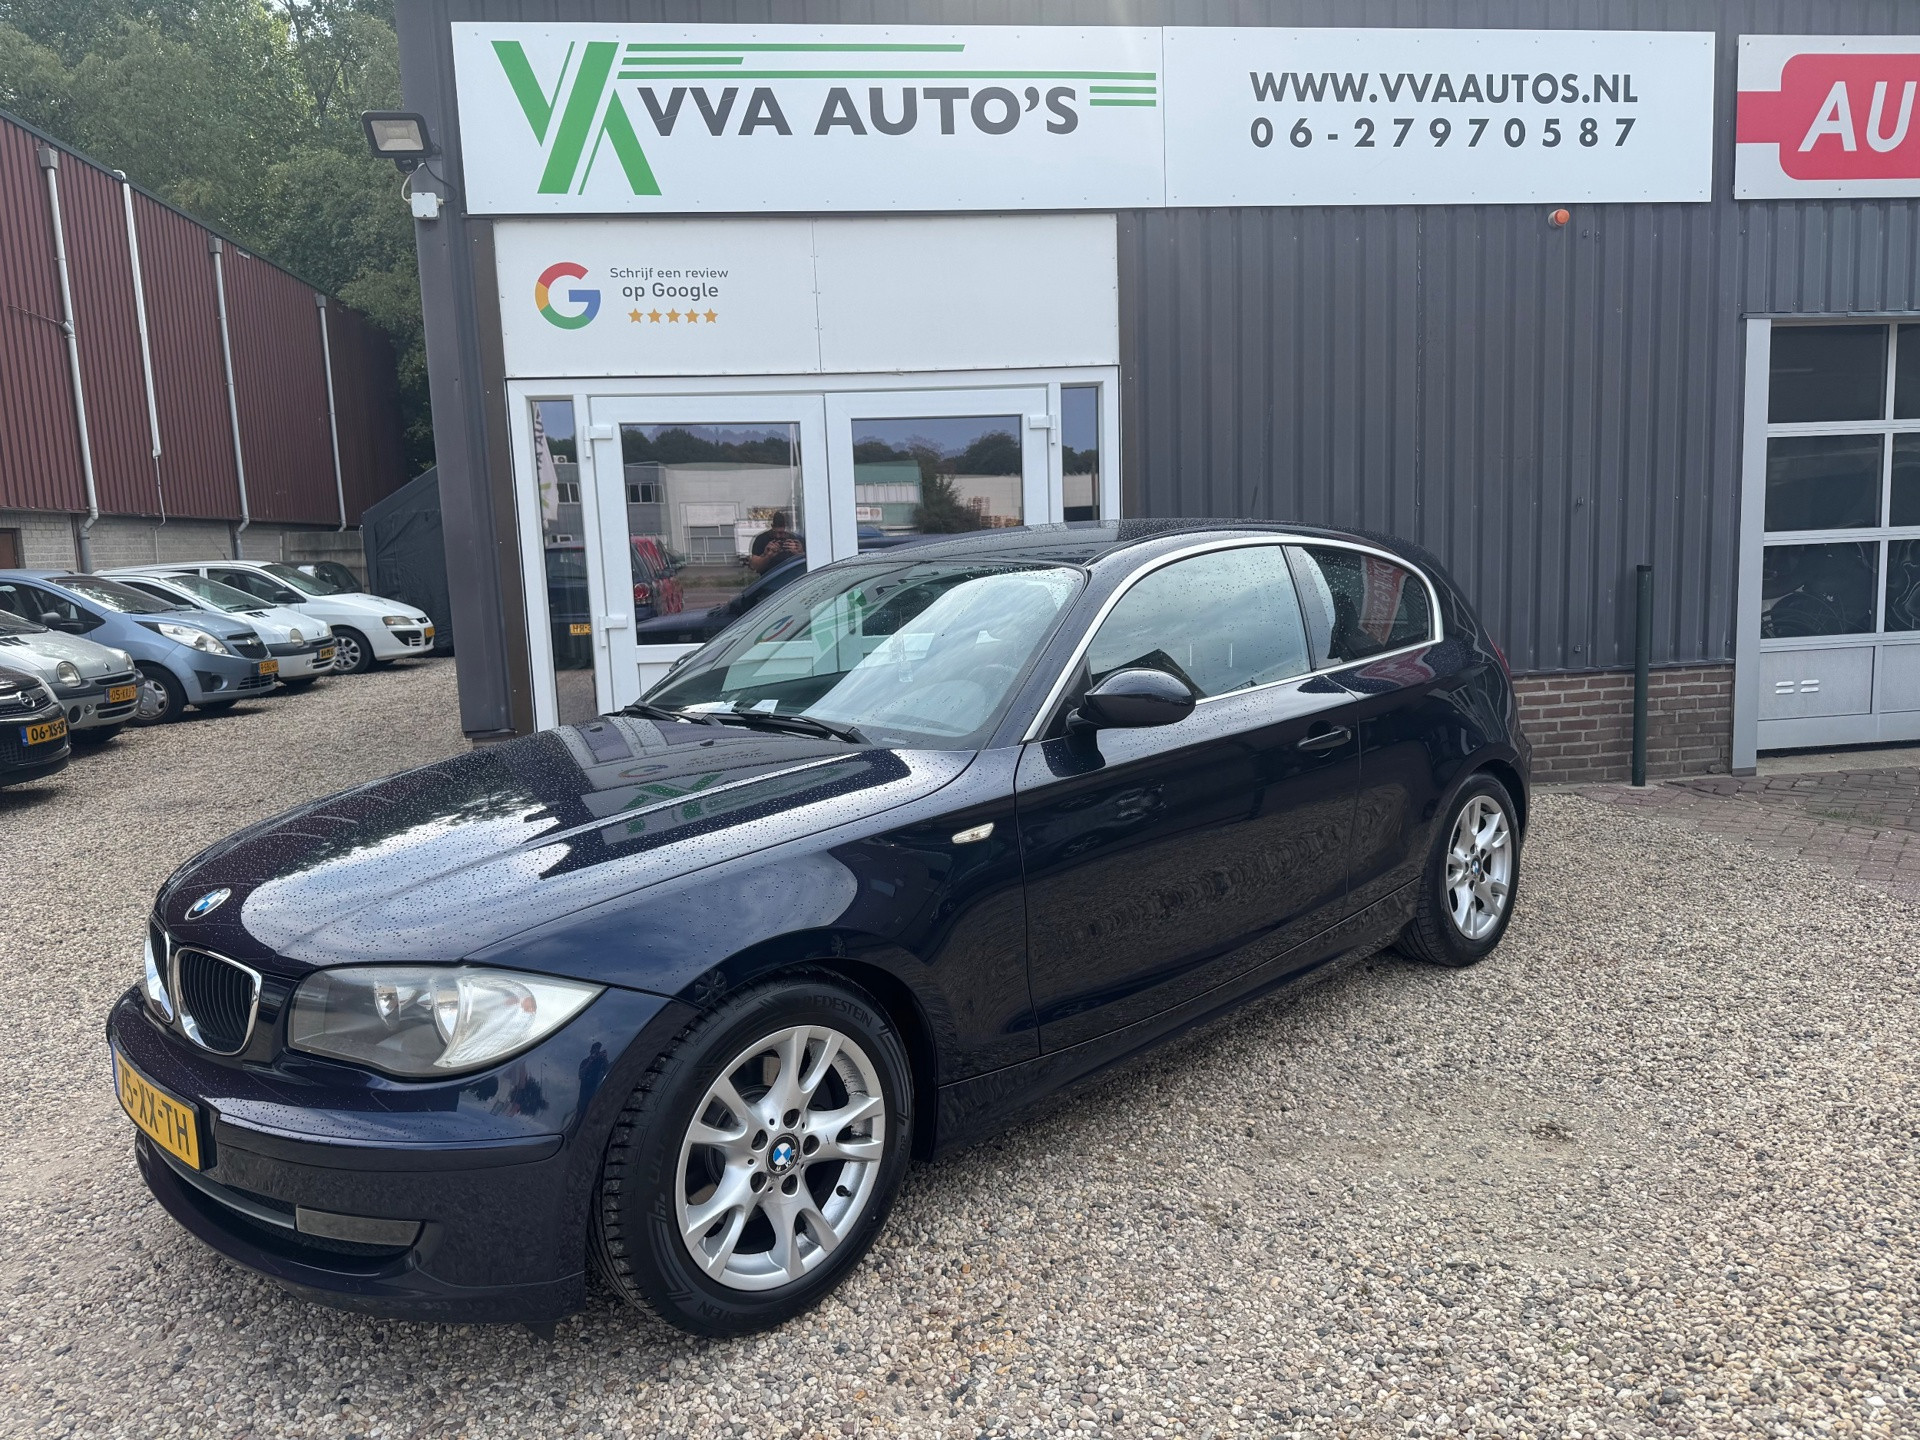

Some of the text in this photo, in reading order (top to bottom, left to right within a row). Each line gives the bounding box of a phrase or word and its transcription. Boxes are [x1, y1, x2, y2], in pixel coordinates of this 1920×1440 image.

[1249, 71, 1638, 105] WWW.VVAAUTOS.NL
[636, 86, 1079, 137] VVA AUTO'S
[609, 267, 729, 281] Schrijf een review
[622, 282, 719, 302] op Google
[118, 1058, 190, 1156] 75-XX-TH
